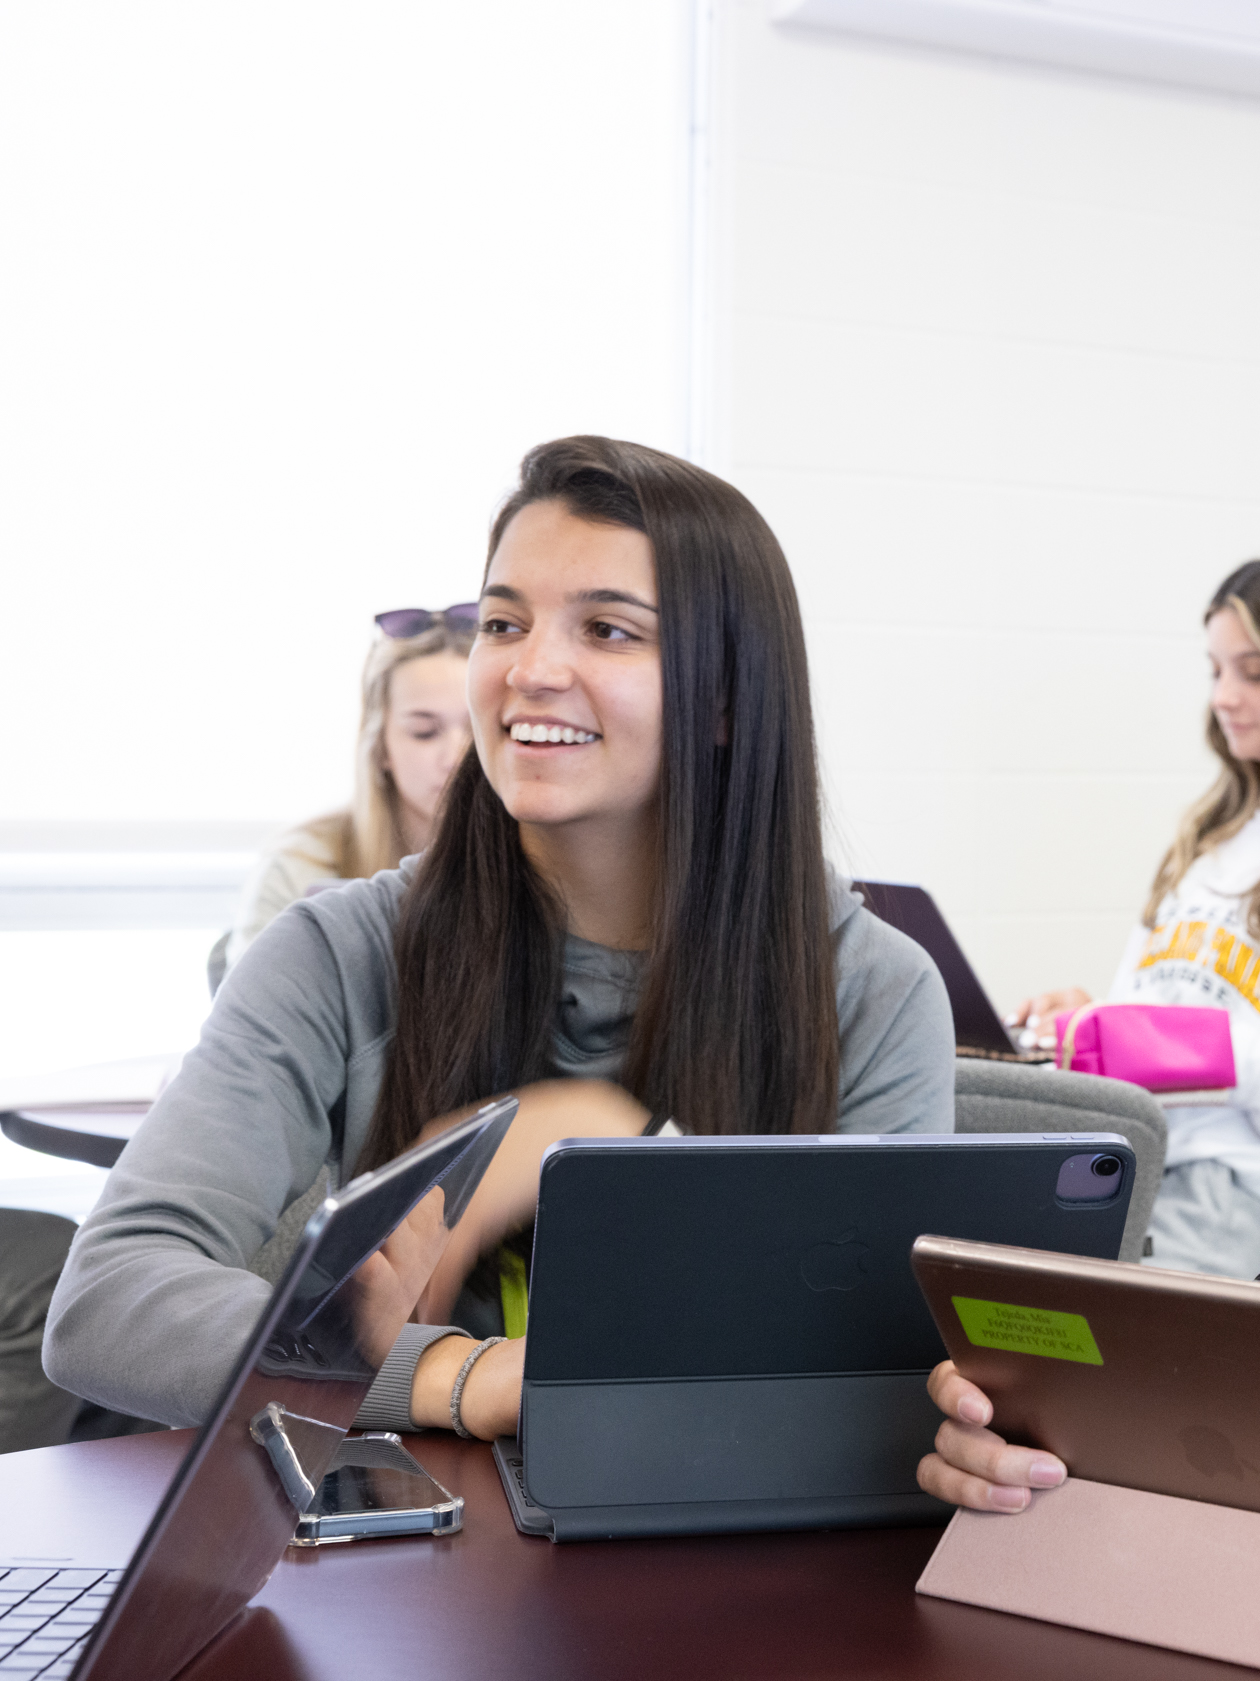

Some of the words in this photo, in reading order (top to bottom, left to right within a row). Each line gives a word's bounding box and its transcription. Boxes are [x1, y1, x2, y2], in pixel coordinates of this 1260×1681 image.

[1029, 1313, 1051, 1324] Mia
[981, 1329, 1041, 1345] PROPERTY
[1041, 1339, 1057, 1348] OF
